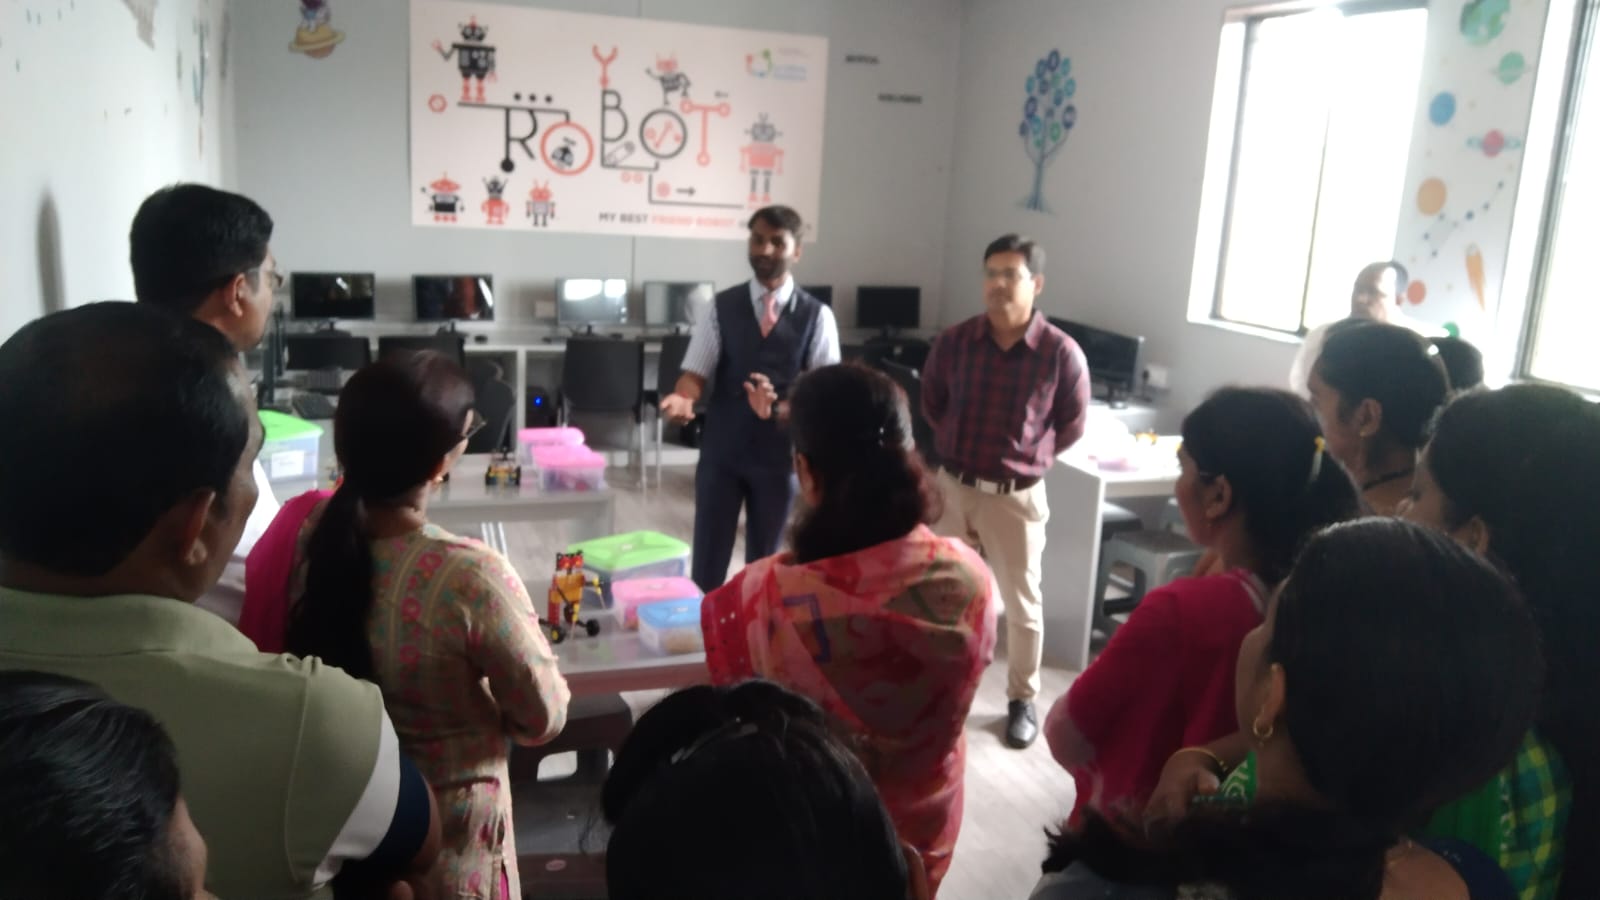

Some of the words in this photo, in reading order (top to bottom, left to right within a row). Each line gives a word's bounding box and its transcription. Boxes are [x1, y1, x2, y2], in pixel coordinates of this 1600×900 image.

[500, 87, 731, 176] ROBOT
[598, 212, 616, 224] MY
[619, 213, 649, 225] BEST
